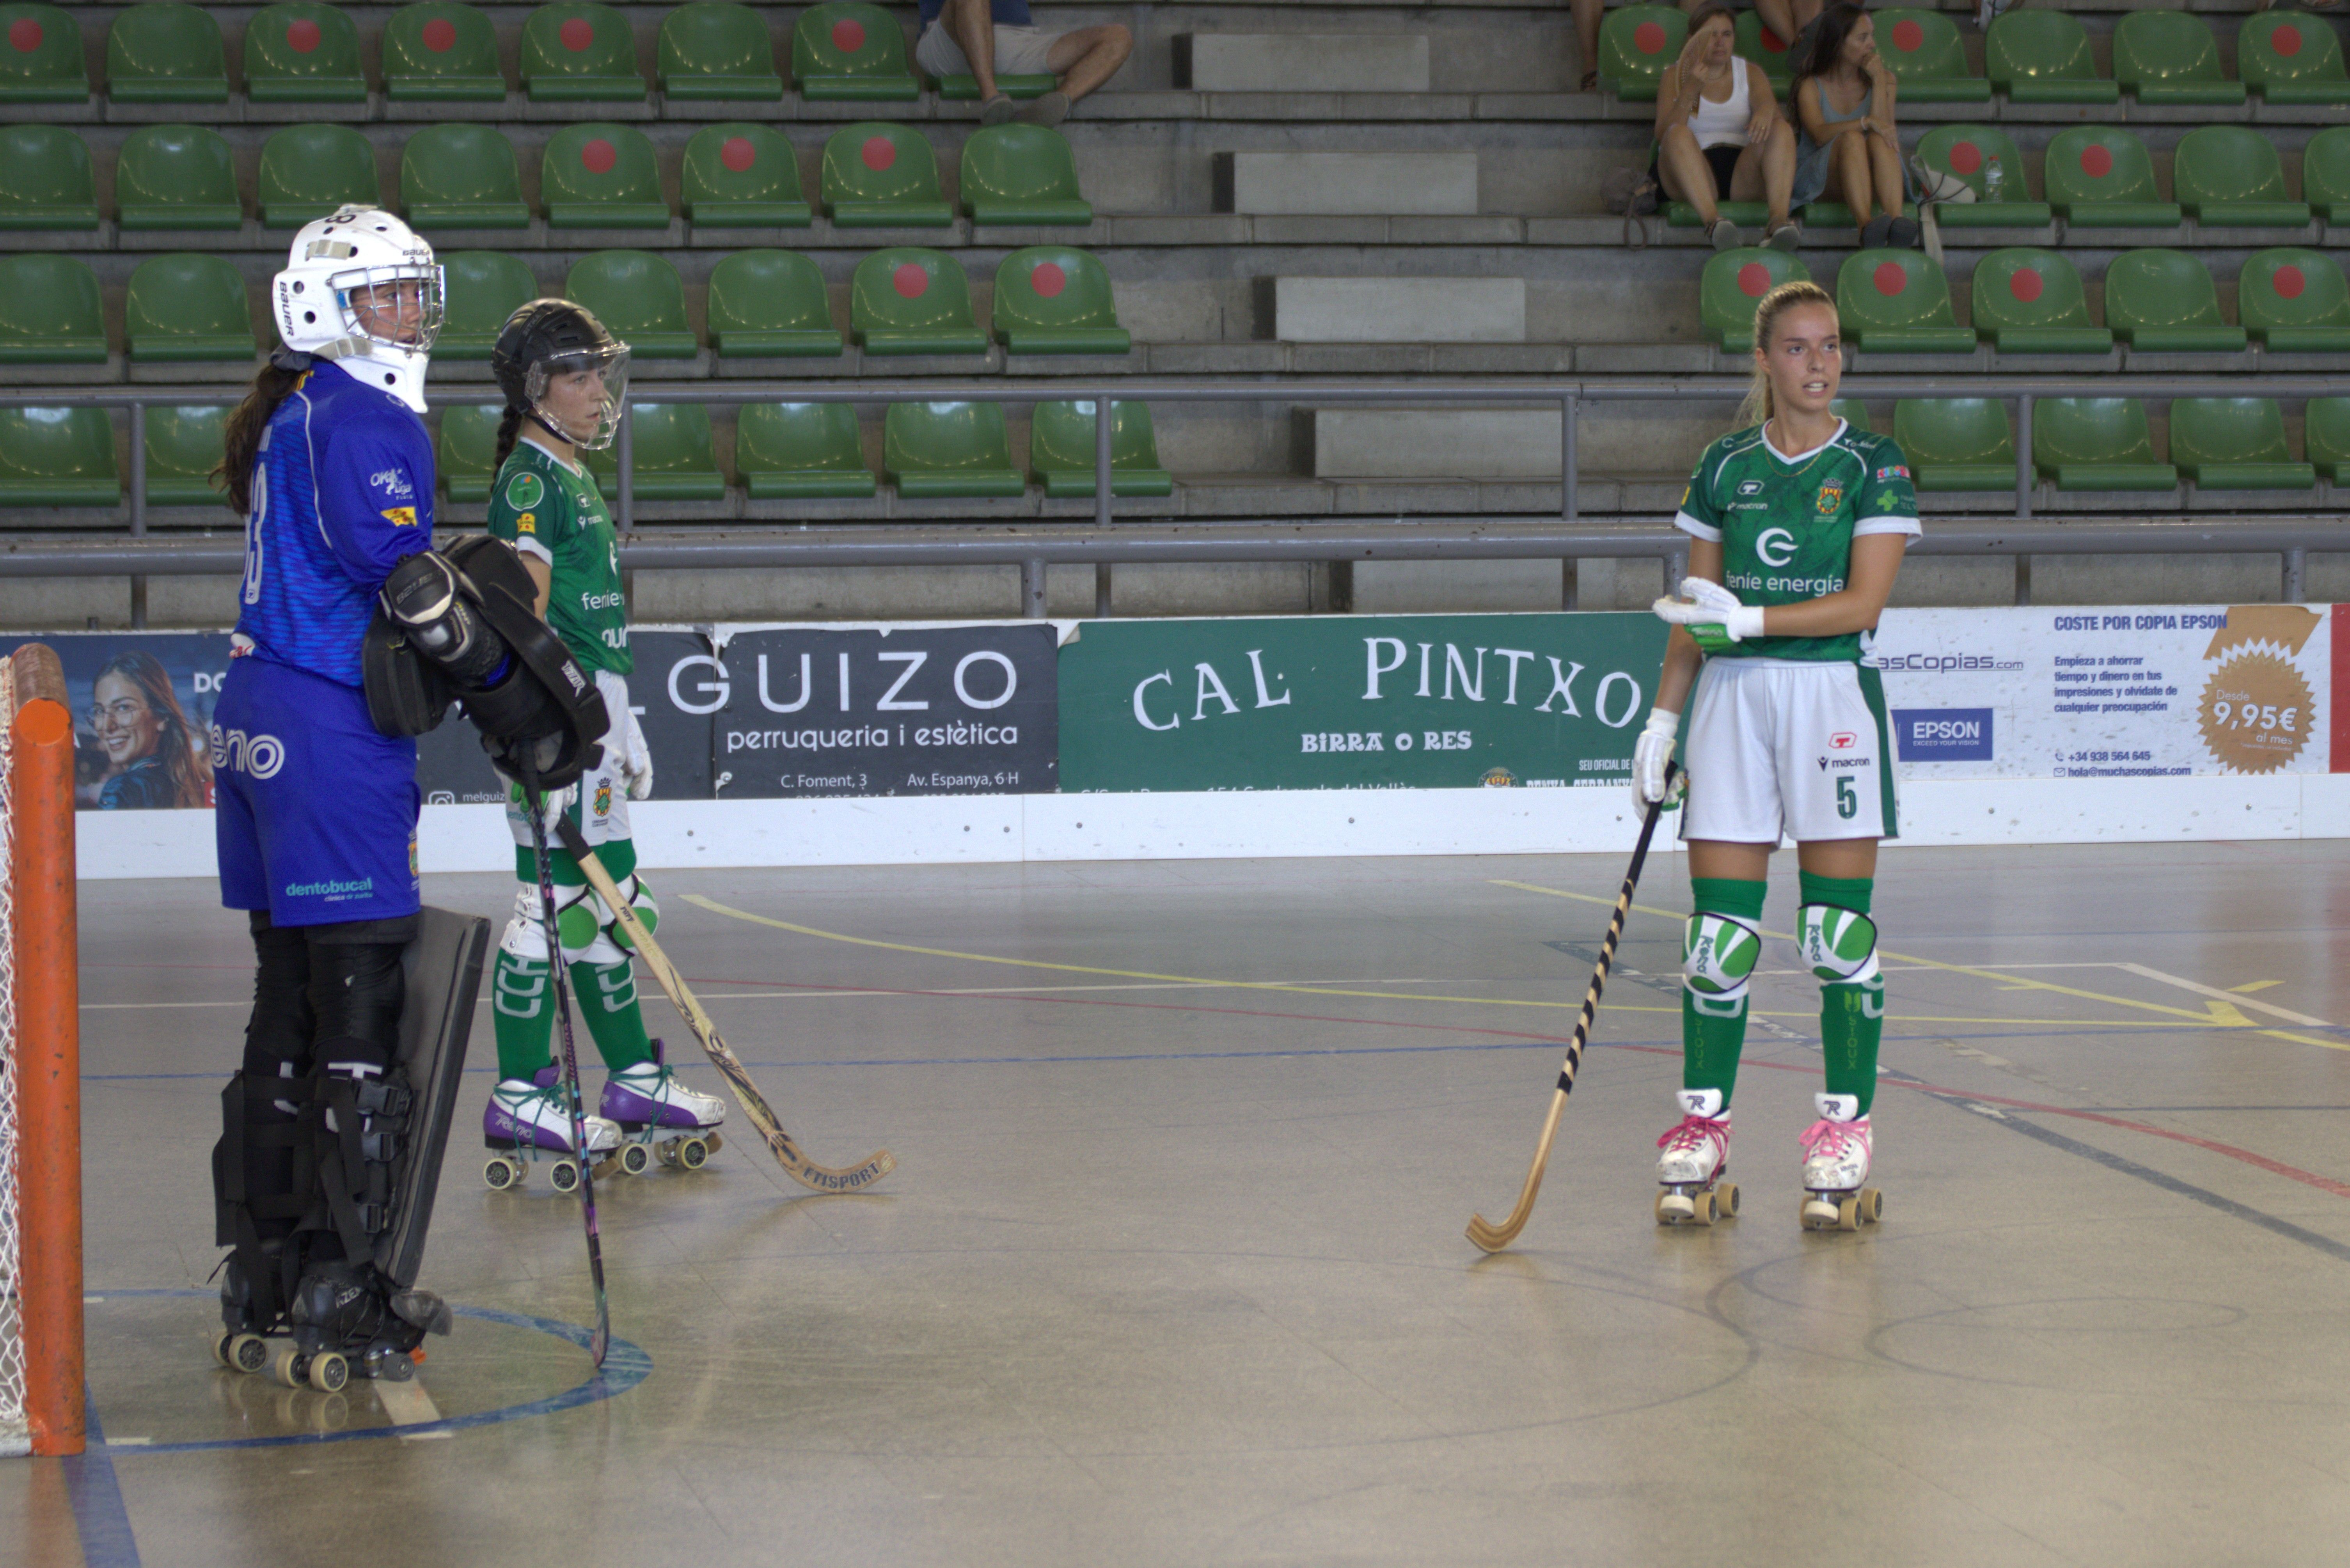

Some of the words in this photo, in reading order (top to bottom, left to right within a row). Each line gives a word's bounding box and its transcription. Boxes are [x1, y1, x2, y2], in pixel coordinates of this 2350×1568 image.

[2054, 616, 2098, 631] COSTE
[2102, 616, 2131, 630] POR
[2135, 615, 2177, 630] COPIA
[2181, 615, 2227, 629] EPSON
[2055, 656, 2095, 668] Empieza
[2107, 656, 2143, 665] ahorrar
[629, 651, 1017, 715] GUIZO
[2054, 673, 2088, 683] tiempo
[2091, 674, 2096, 683] y
[2099, 671, 2129, 681] dinero
[2147, 671, 2162, 680] tus
[1133, 649, 1290, 731] CAL
[2054, 687, 2113, 699] impresiones
[2116, 688, 2122, 698] y
[2165, 686, 2177, 695] de
[2217, 690, 2250, 701] Desde
[2054, 702, 2099, 714] cualquier
[2102, 701, 2168, 713] preocupación
[2213, 702, 2298, 731] 9,95€
[728, 725, 888, 753] perruqueria
[900, 724, 904, 746] i
[914, 720, 1018, 746] estètica
[1913, 722, 1979, 739] EPSON
[2256, 732, 2267, 742] al
[2270, 736, 2293, 745] mes
[1424, 731, 1472, 751] RES
[1832, 758, 1870, 768] macron
[2068, 752, 2087, 761] +34
[2090, 752, 2109, 761] 938
[2111, 751, 2130, 761] 564
[2132, 751, 2150, 761] 645
[1579, 759, 1592, 771] SEU
[1594, 759, 1620, 770] OFICIAL
[1621, 759, 1630, 770] DE
[2068, 766, 2191, 777] hola@muchascopias.com
[798, 773, 856, 789] Foment,
[859, 773, 867, 786] 3
[907, 773, 928, 787] Av.
[932, 773, 992, 789] Espanya,
[1837, 775, 1857, 819] 5
[286, 876, 372, 896] dentobucal
